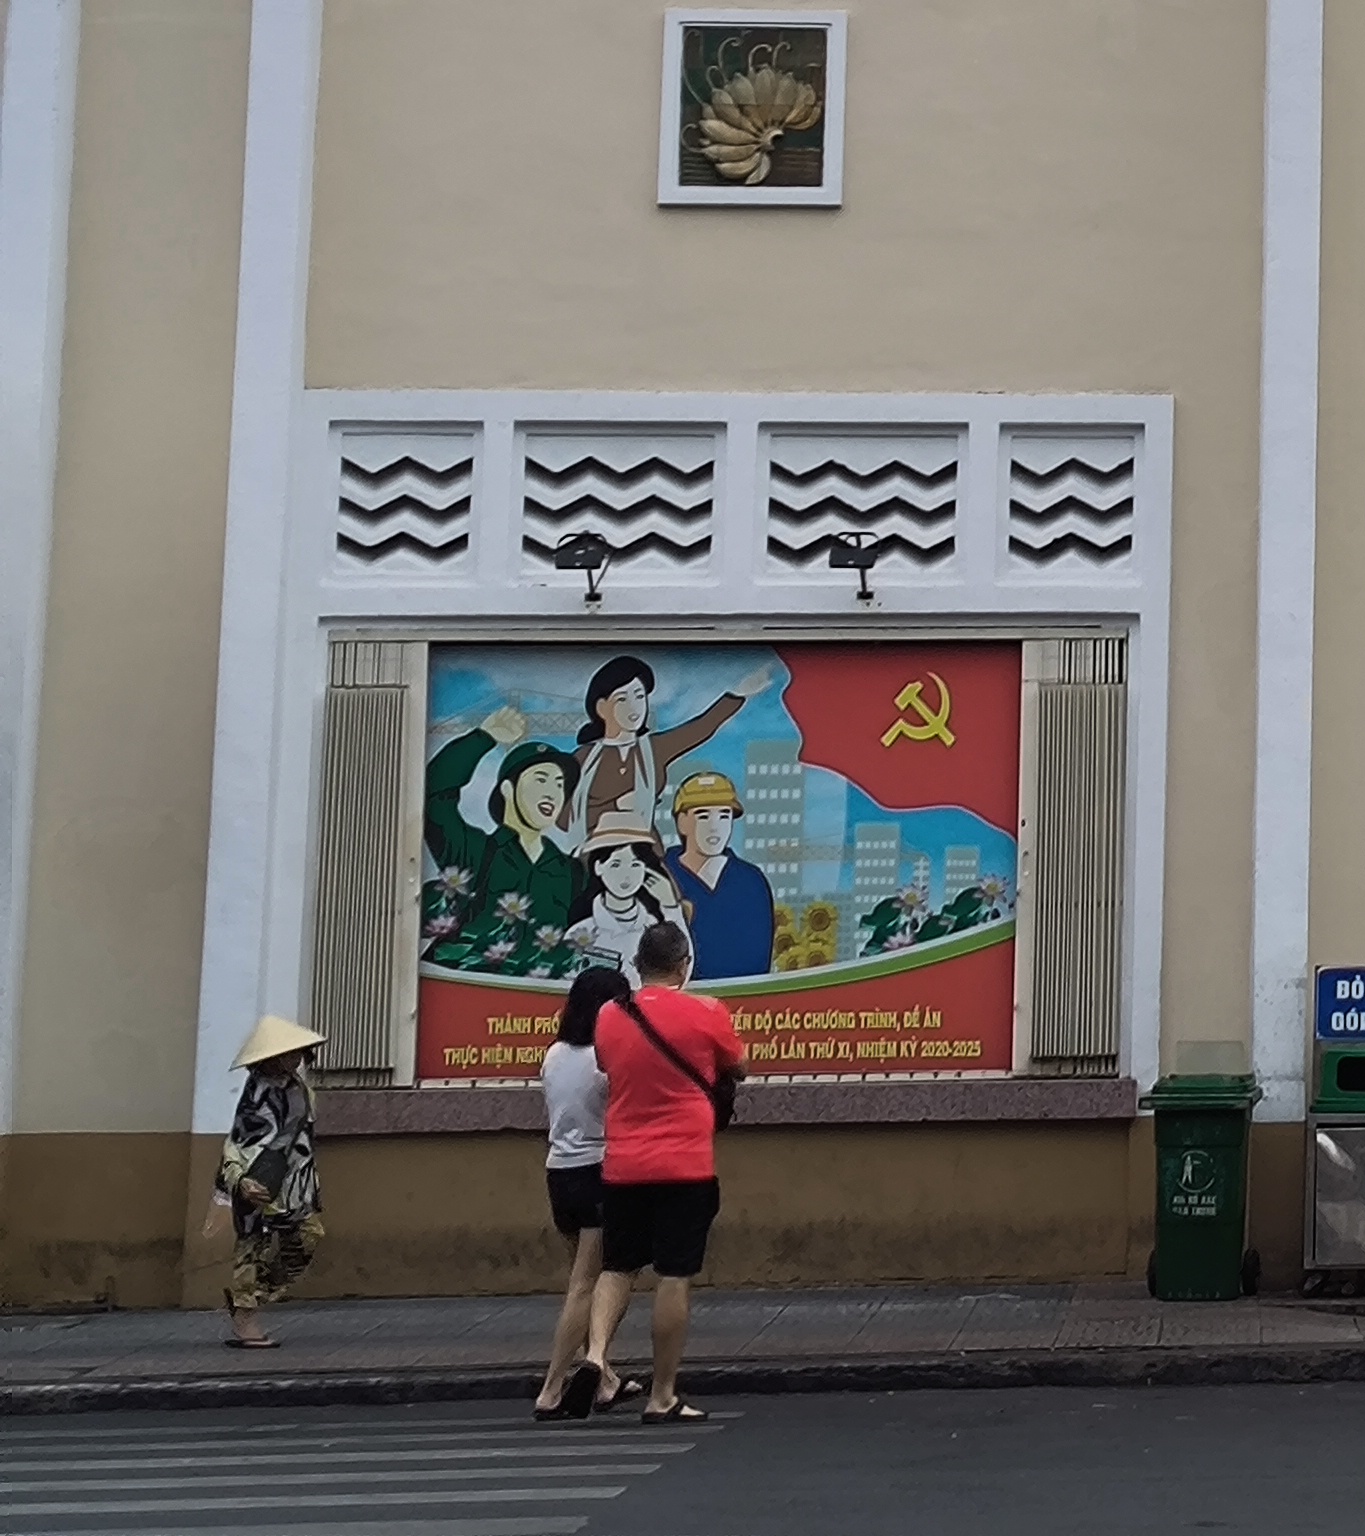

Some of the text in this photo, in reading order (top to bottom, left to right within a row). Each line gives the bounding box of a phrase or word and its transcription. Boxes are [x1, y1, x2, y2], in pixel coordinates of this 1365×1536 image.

[1336, 974, 1365, 999] BỎ
[486, 1012, 531, 1034] THÀNH
[754, 1009, 772, 1035] ĐỘ
[775, 1007, 801, 1030] CÁC
[803, 1008, 856, 1030] CHƯƠNG
[923, 1006, 941, 1028] ÁN
[443, 1044, 479, 1070] THỰC
[481, 1043, 513, 1069] HIỆN
[752, 1034, 778, 1060] PHỐ
[808, 1036, 836, 1060] THỨ
[856, 1037, 897, 1063] NHIỆM
[920, 1040, 981, 1058] 2020-2025
